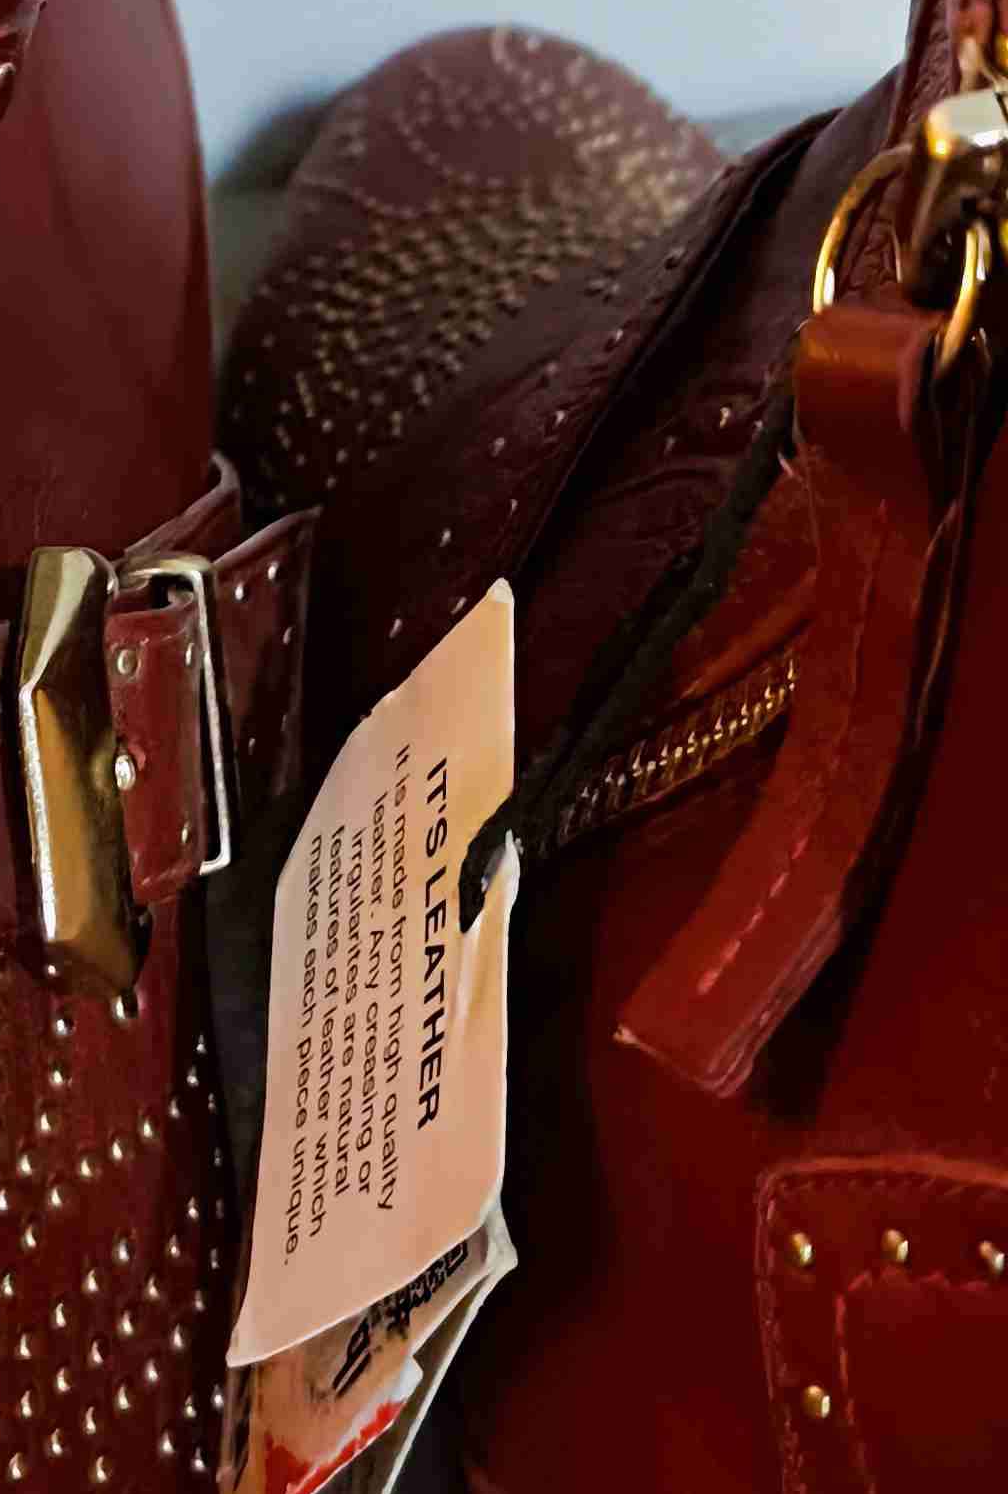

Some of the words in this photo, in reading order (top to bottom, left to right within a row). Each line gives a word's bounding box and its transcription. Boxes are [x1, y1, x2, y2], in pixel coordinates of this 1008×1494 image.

[393, 772, 411, 807] is
[395, 743, 411, 770] It
[425, 756, 449, 858] IT'S
[304, 834, 324, 940] makes
[324, 825, 347, 959] features
[391, 813, 408, 910] made
[300, 947, 317, 1028] each
[325, 967, 338, 998] of
[365, 929, 385, 990] Any
[389, 914, 408, 997] from
[416, 865, 448, 1131] LEATHER
[294, 1036, 313, 1129] piece
[316, 1008, 338, 1123] leather
[342, 1012, 358, 1068] are
[356, 1001, 381, 1152] creasing
[382, 1003, 405, 1084] high
[334, 1076, 354, 1196] natural
[357, 1160, 373, 1196] or
[377, 1093, 400, 1211] quality
[308, 1131, 329, 1238] which
